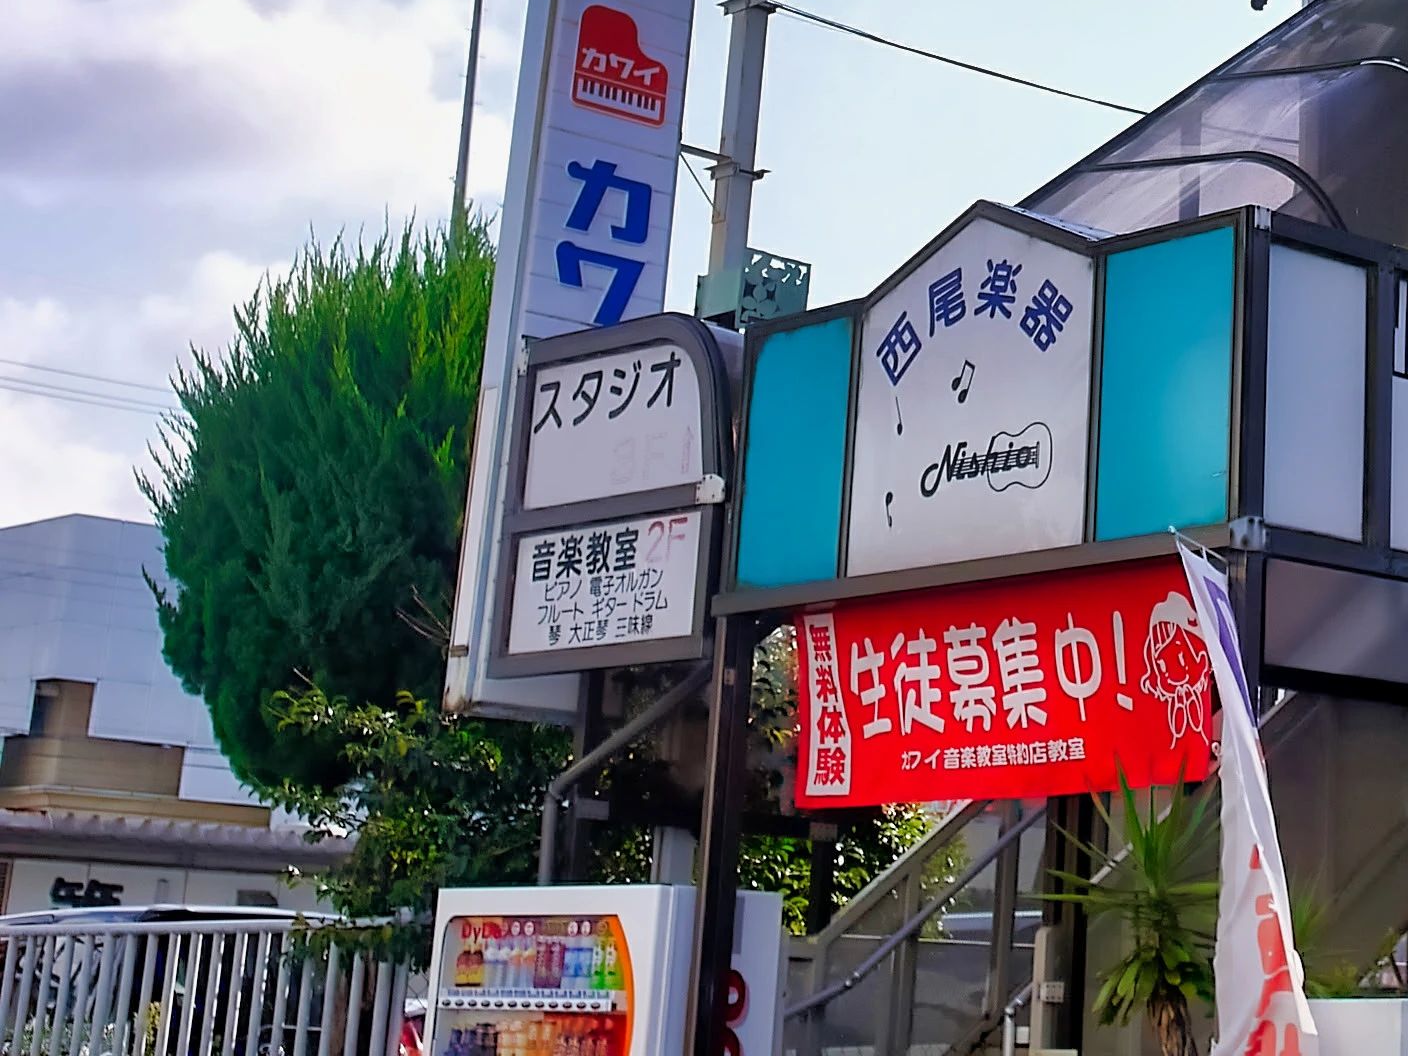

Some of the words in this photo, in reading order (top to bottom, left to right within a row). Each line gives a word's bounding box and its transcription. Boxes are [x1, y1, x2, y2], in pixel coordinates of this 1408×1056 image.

[581, 47, 660, 87] カワイ
[876, 259, 1074, 386] 西尾楽器
[533, 351, 682, 434] スタジオ
[920, 436, 1033, 497] Nishio
[532, 526, 639, 582] 音楽教室
[645, 517, 689, 563] 2F
[538, 602, 584, 625] フルート
[591, 597, 628, 618] ギター
[633, 590, 668, 613] ドラム
[544, 580, 583, 602] ピアノ
[590, 569, 664, 598] 電子オルガン
[568, 619, 609, 645] 大正琴
[615, 614, 653, 639] 三味線
[808, 623, 847, 787] 無料体験
